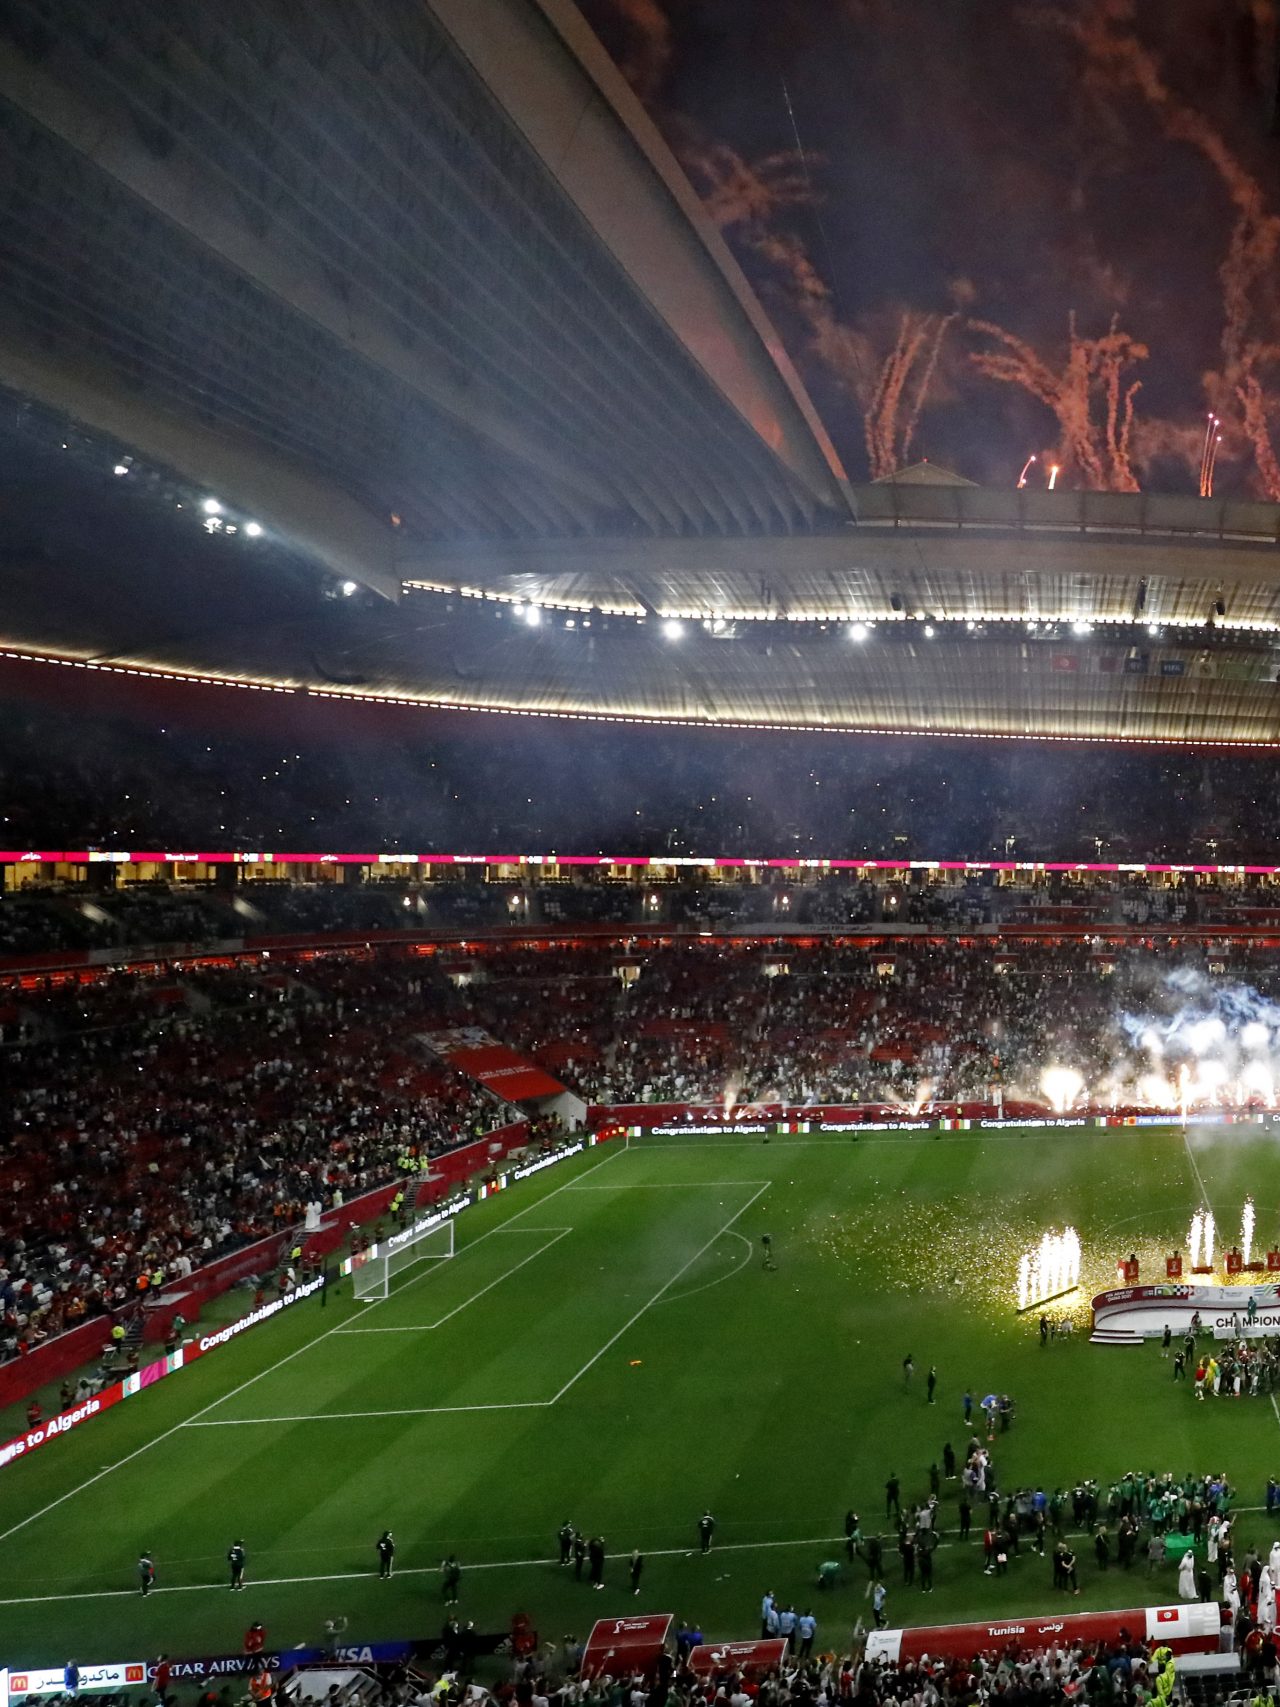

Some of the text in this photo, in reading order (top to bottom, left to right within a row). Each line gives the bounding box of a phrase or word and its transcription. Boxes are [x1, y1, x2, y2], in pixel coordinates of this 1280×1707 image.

[820, 1123, 888, 1132] Congratulations
[899, 1122, 930, 1130] Algeria
[981, 1120, 1045, 1128] Congratulations
[1056, 1119, 1085, 1127] Algeria
[651, 1125, 766, 1136] Congratulations to Algeria
[200, 1300, 283, 1350] Congratulations
[284, 1294, 294, 1305] to
[27, 1399, 100, 1447] to Algeria
[988, 1626, 1025, 1637] Tunisia
[1038, 1622, 1064, 1633] تونس
